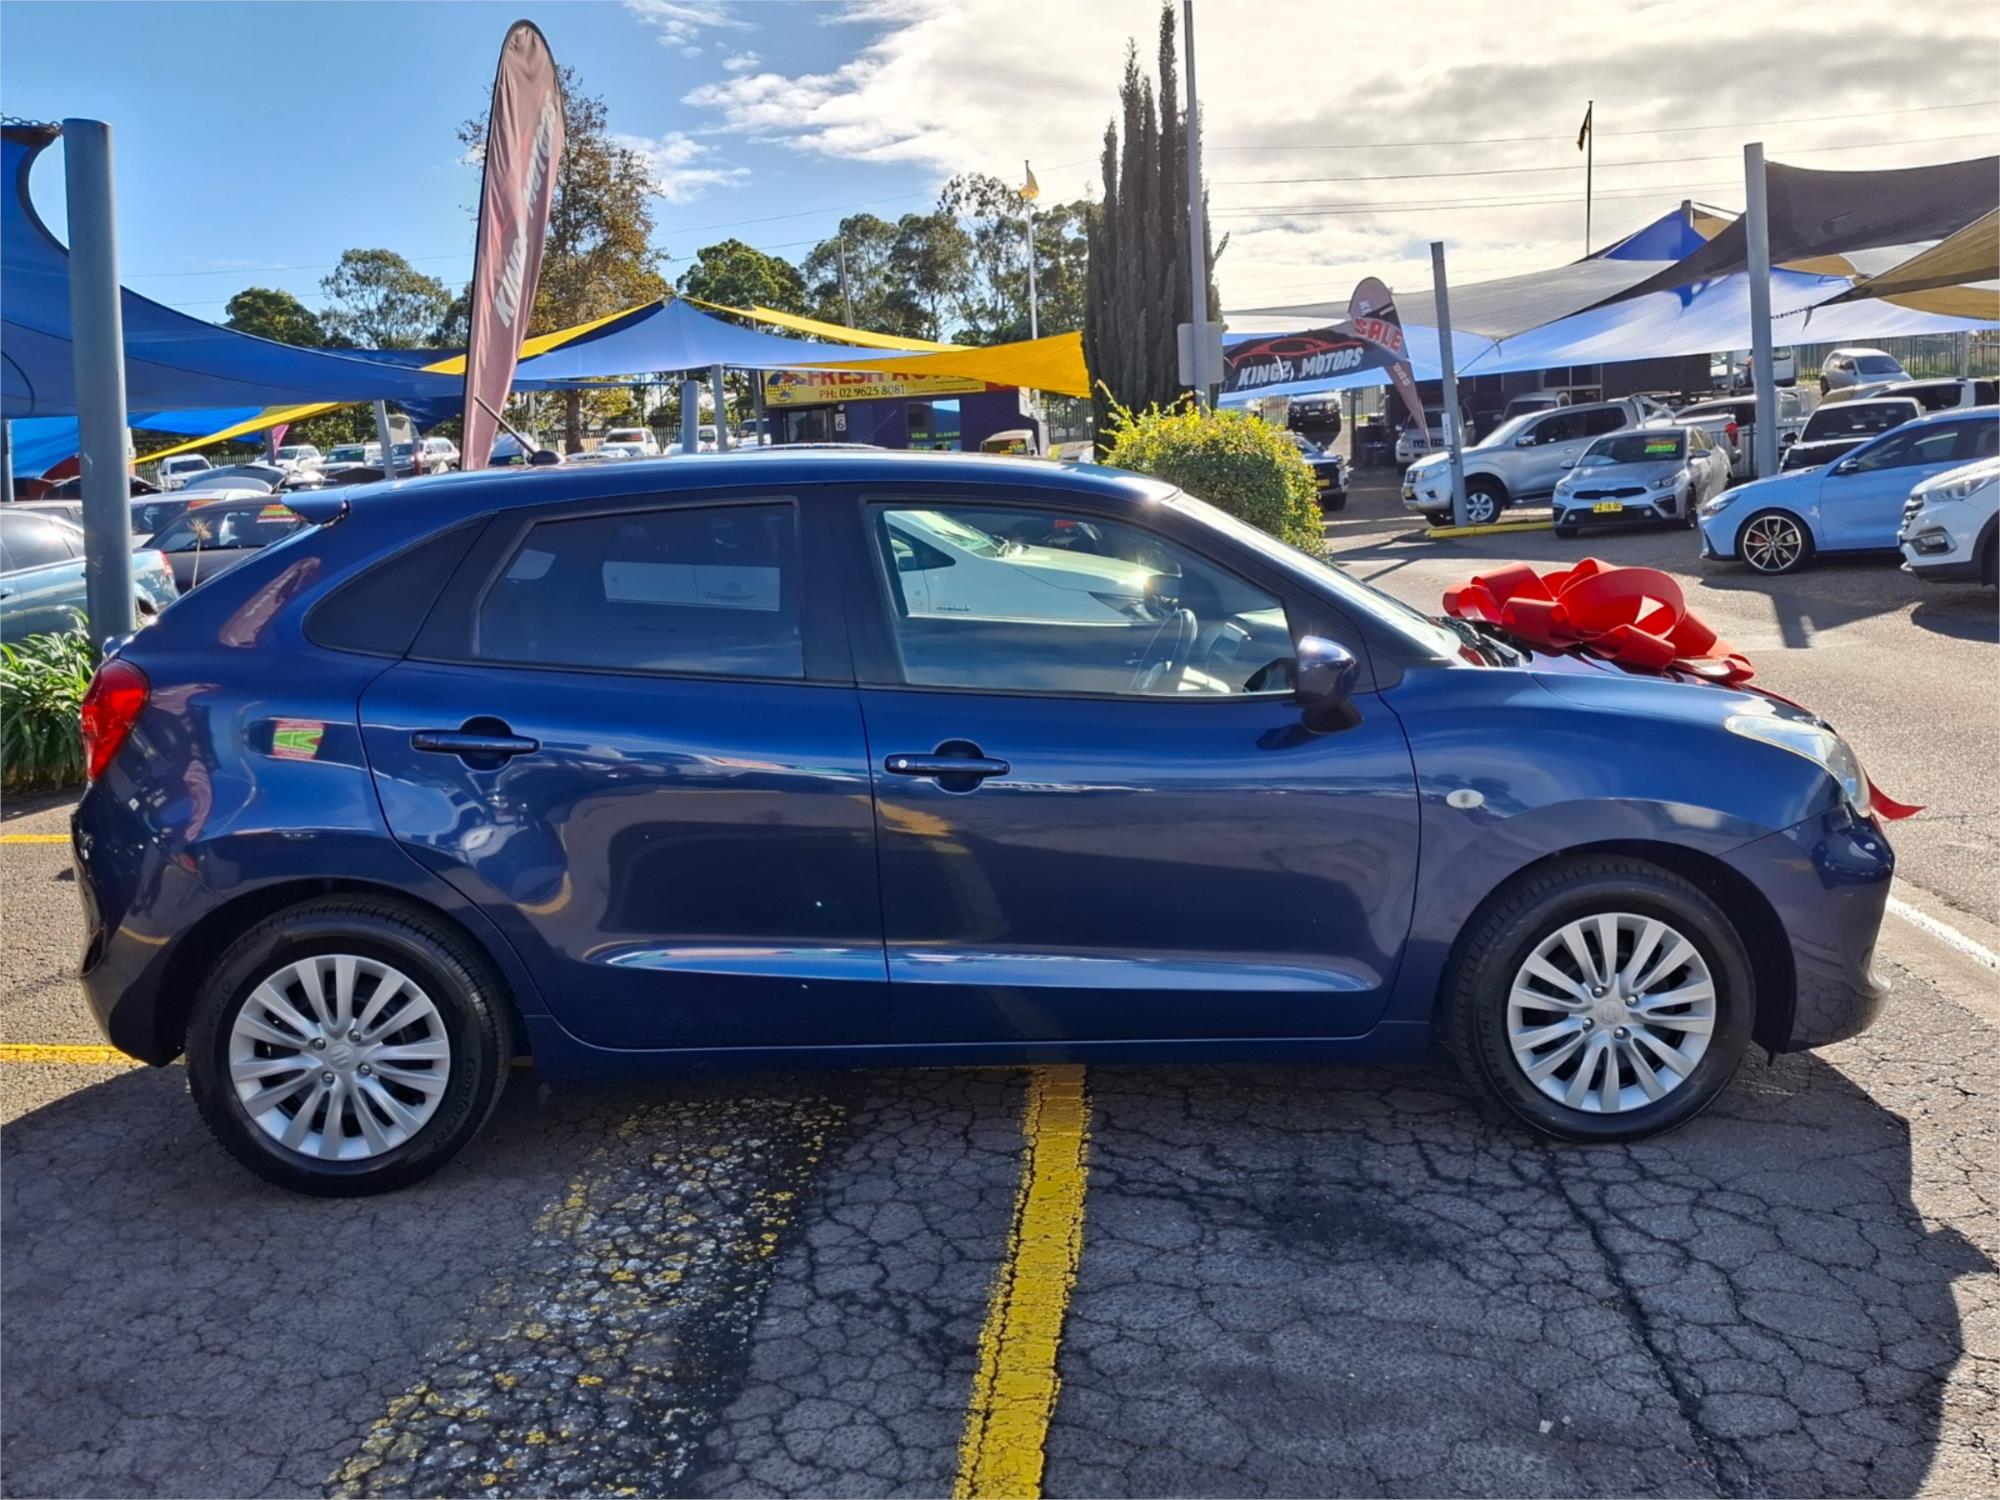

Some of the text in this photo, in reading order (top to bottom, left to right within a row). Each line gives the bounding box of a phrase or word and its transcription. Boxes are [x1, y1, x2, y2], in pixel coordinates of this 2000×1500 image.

[1355, 318, 1403, 353] SALE
[1301, 346, 1365, 377] MOTORS
[820, 389, 838, 400] PH:
[840, 387, 852, 398] 02
[855, 385, 879, 397] 9625
[881, 383, 906, 396] 8081
